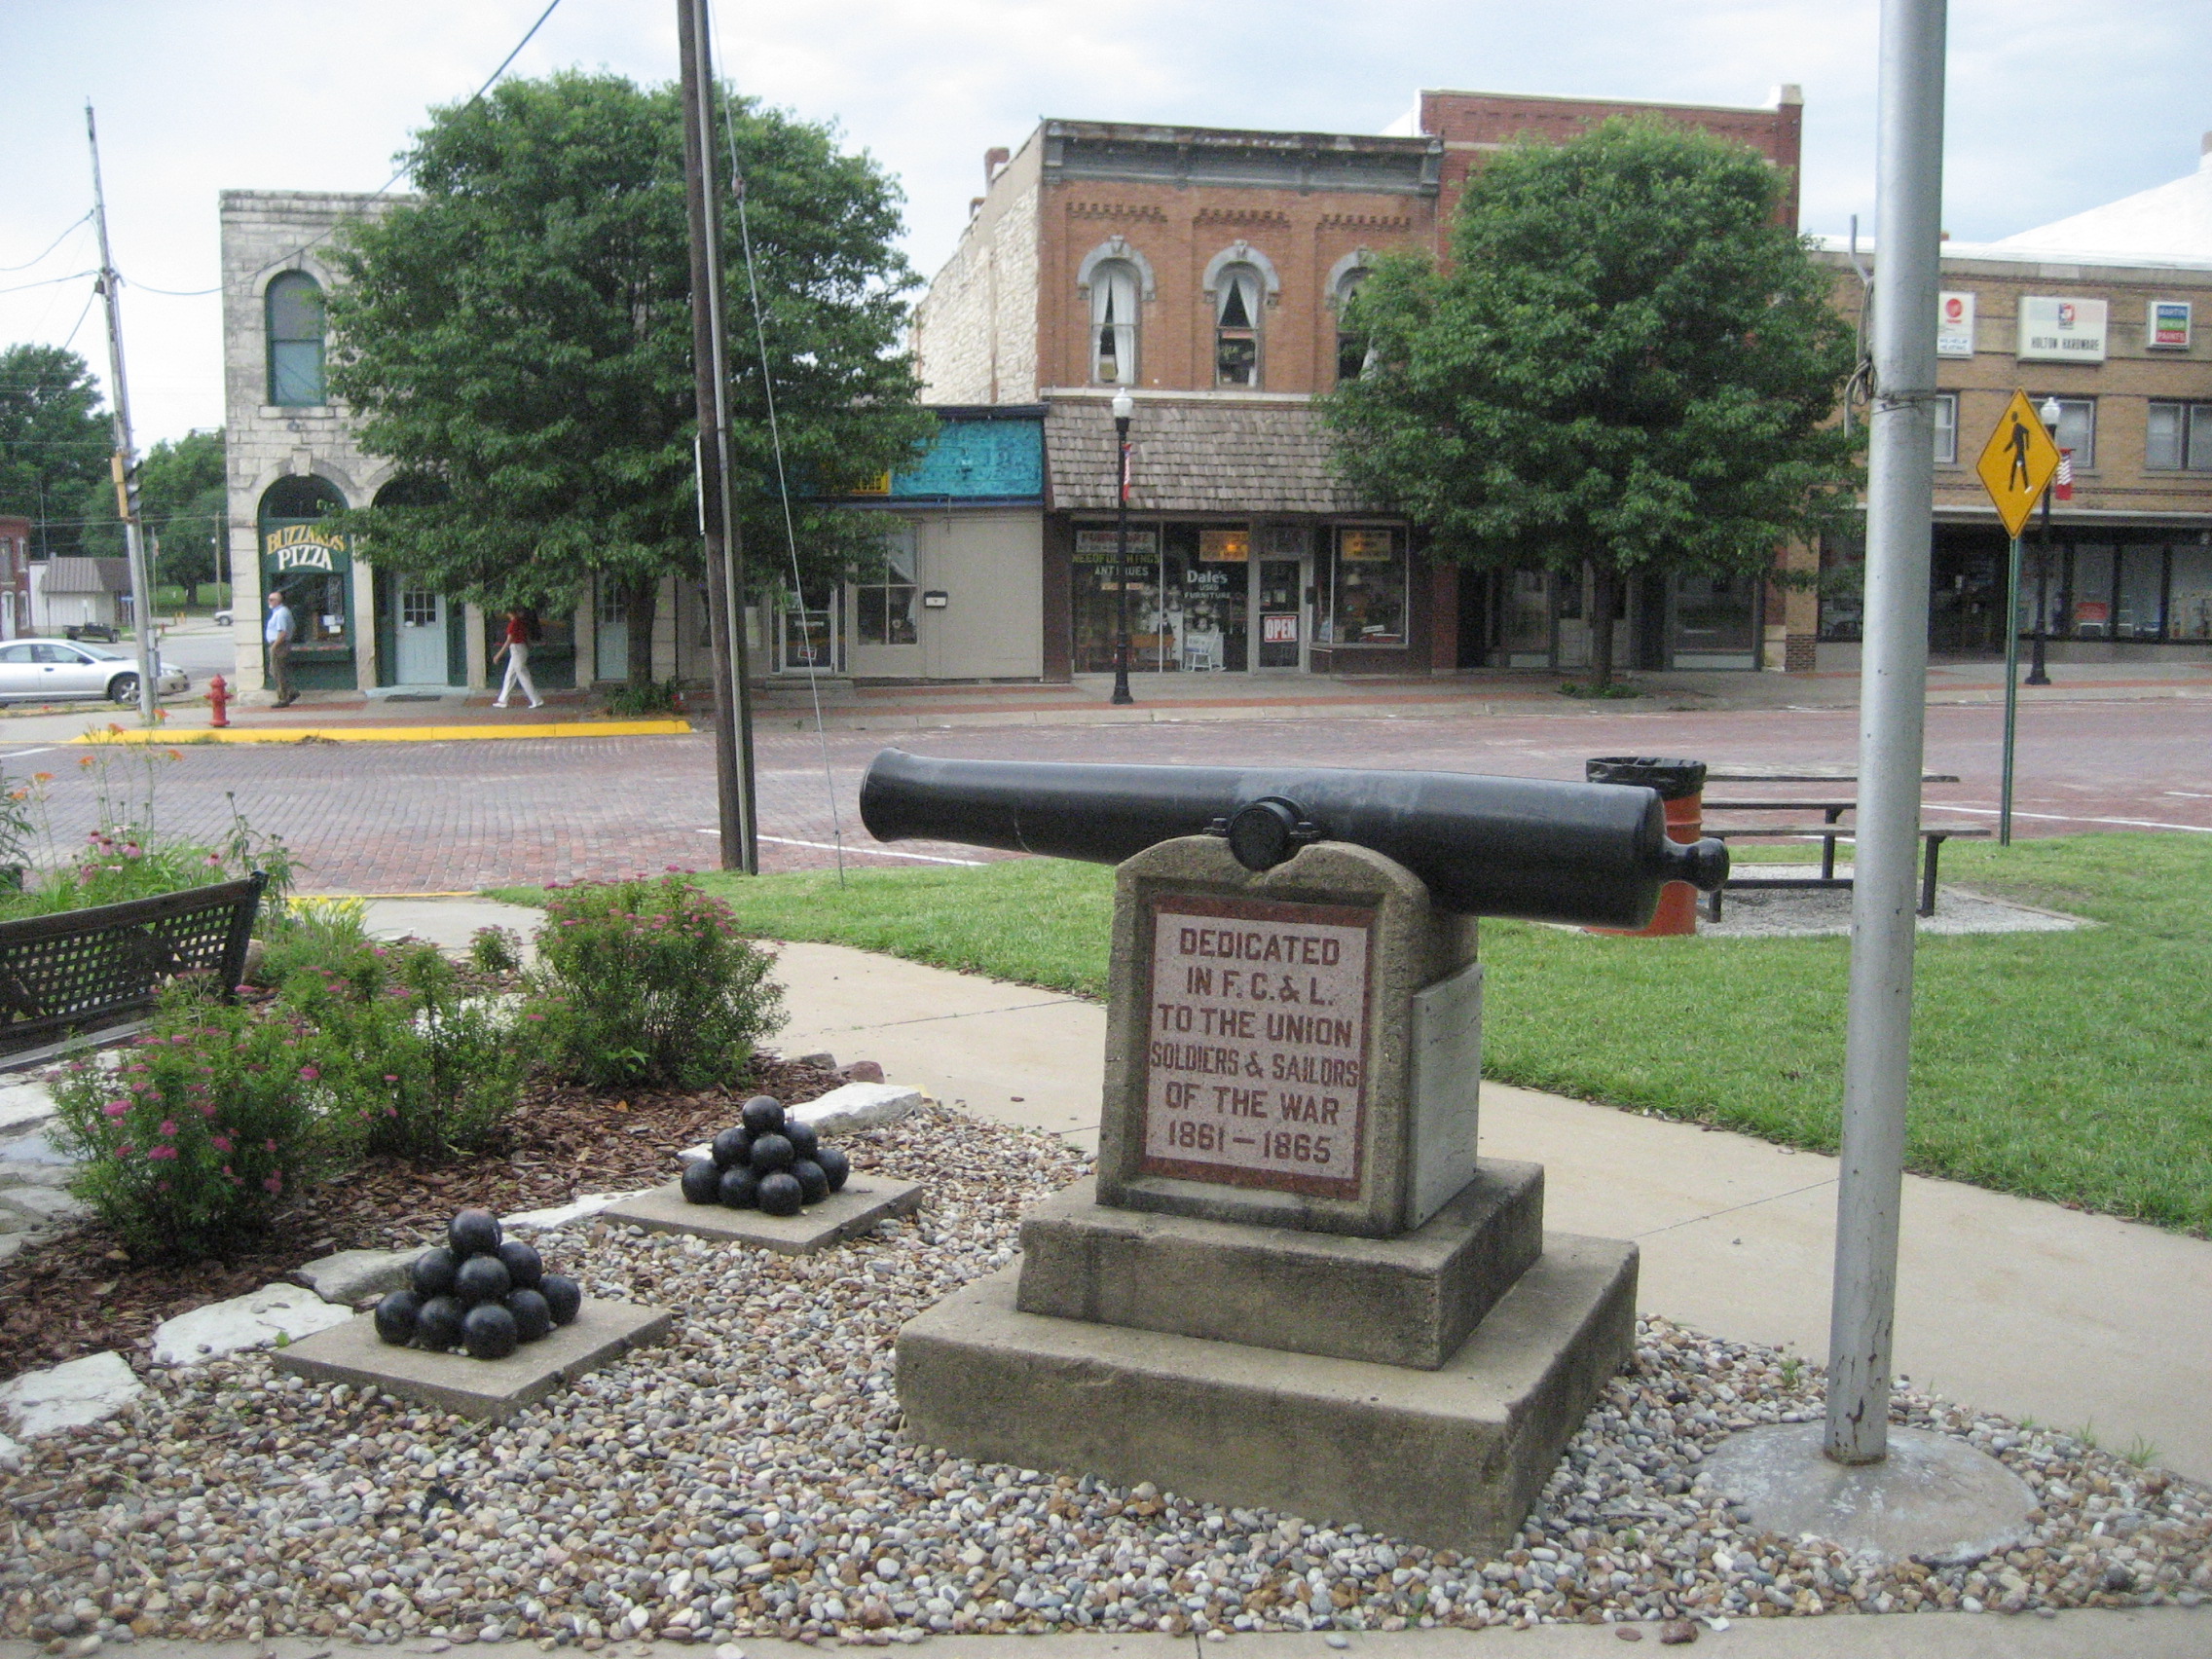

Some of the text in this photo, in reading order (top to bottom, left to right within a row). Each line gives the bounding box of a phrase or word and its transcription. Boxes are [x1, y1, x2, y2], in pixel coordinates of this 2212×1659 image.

[2031, 336, 2099, 350] HOLTON HARDWARE
[277, 544, 333, 571] PIZZA
[1094, 566, 1149, 576] ANTIUES
[1124, 553, 1160, 565] HINGS
[1187, 570, 1229, 583] Dale's
[1267, 618, 1296, 640] OPEN
[1179, 928, 1340, 966] DEDICATED
[1186, 967, 1212, 996] IN
[1309, 977, 1334, 1006] L.
[1158, 1003, 1352, 1048] TO THE UNION
[1150, 1041, 1360, 1088] SOLDIERS & SAILORS
[1165, 1081, 1340, 1125] OF THE WAR
